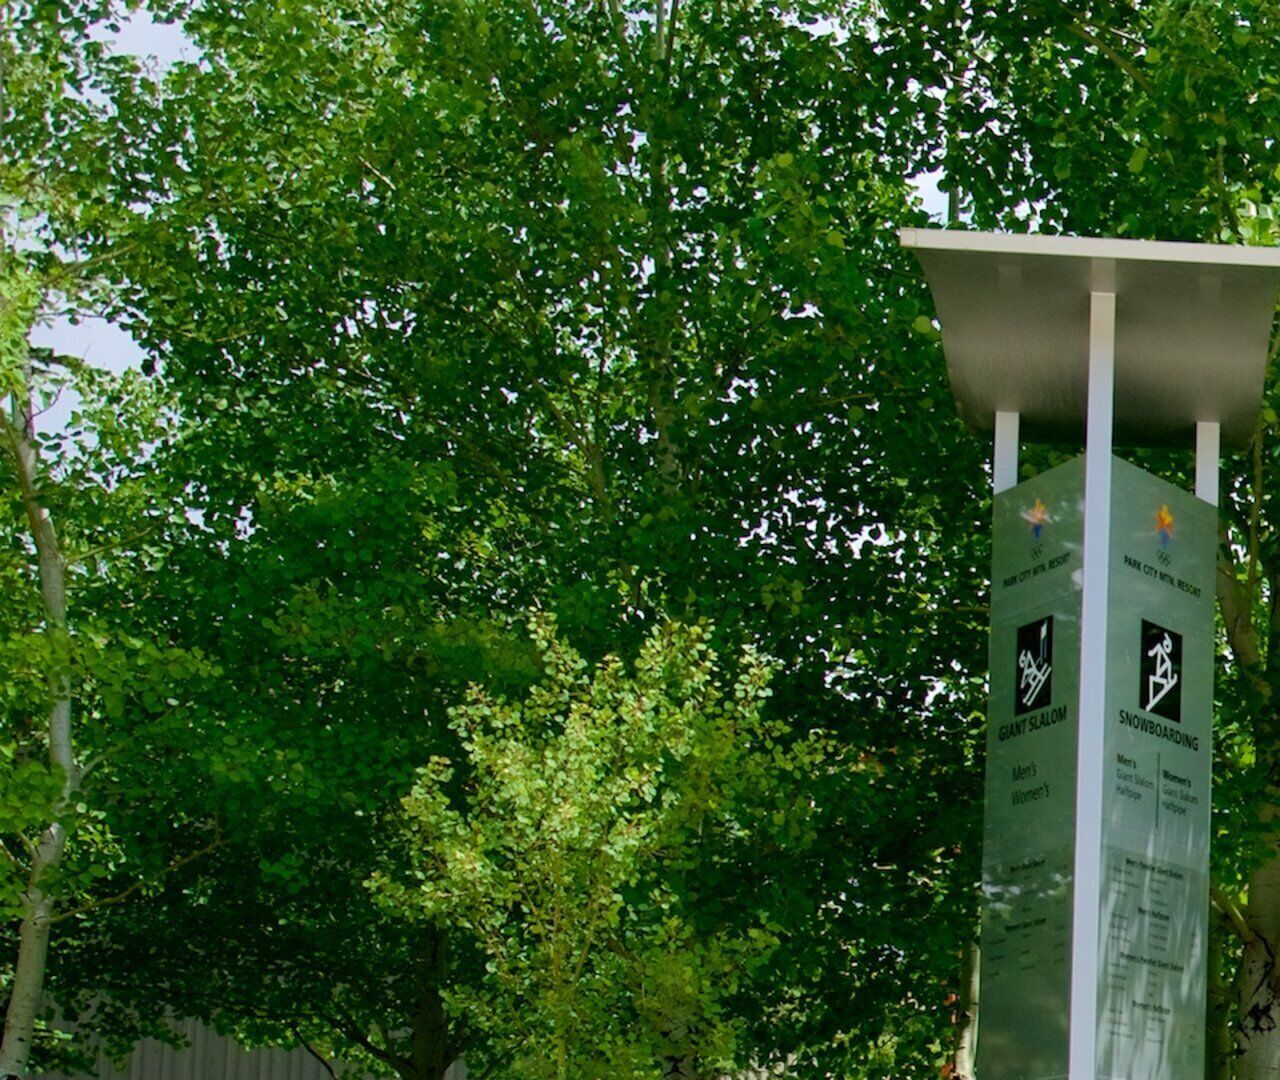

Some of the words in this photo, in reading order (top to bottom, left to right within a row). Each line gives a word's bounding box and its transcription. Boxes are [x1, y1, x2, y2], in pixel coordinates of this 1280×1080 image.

[1124, 555, 1142, 571] PARK
[1143, 564, 1158, 578] CITY
[1177, 579, 1201, 597] RESORT
[999, 718, 1027, 742] GIANT
[1029, 705, 1068, 732] SLALOM
[1119, 710, 1200, 752] SNOWBOARDING
[1012, 761, 1037, 781] Men's
[1011, 782, 1050, 807] Women's
